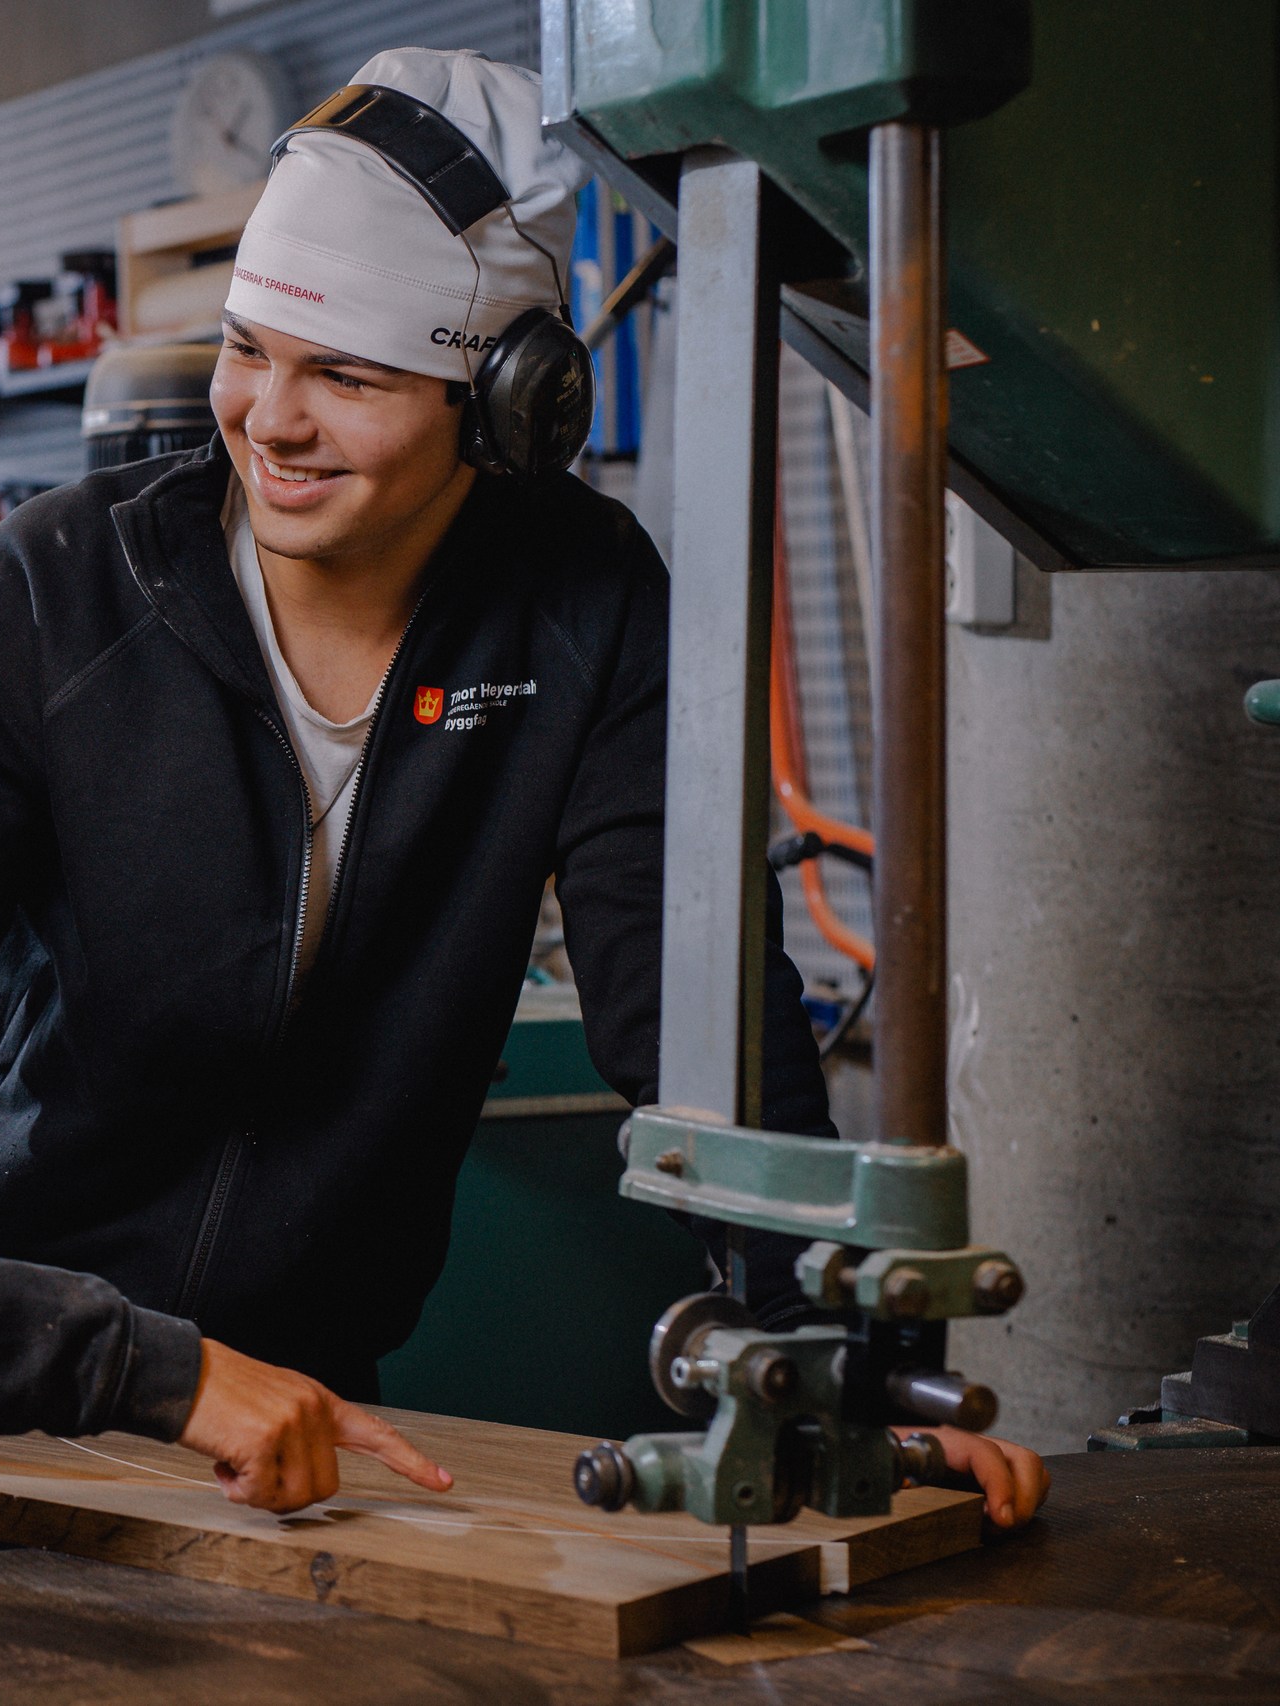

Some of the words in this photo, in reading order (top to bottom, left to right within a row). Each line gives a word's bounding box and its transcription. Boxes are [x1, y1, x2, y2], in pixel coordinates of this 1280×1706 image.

[264, 278, 325, 304] SPAREBANK
[430, 327, 497, 352] CRAF
[450, 687, 477, 706] Thor
[480, 679, 537, 699] Heyerah
[444, 713, 488, 731] Byggfag
